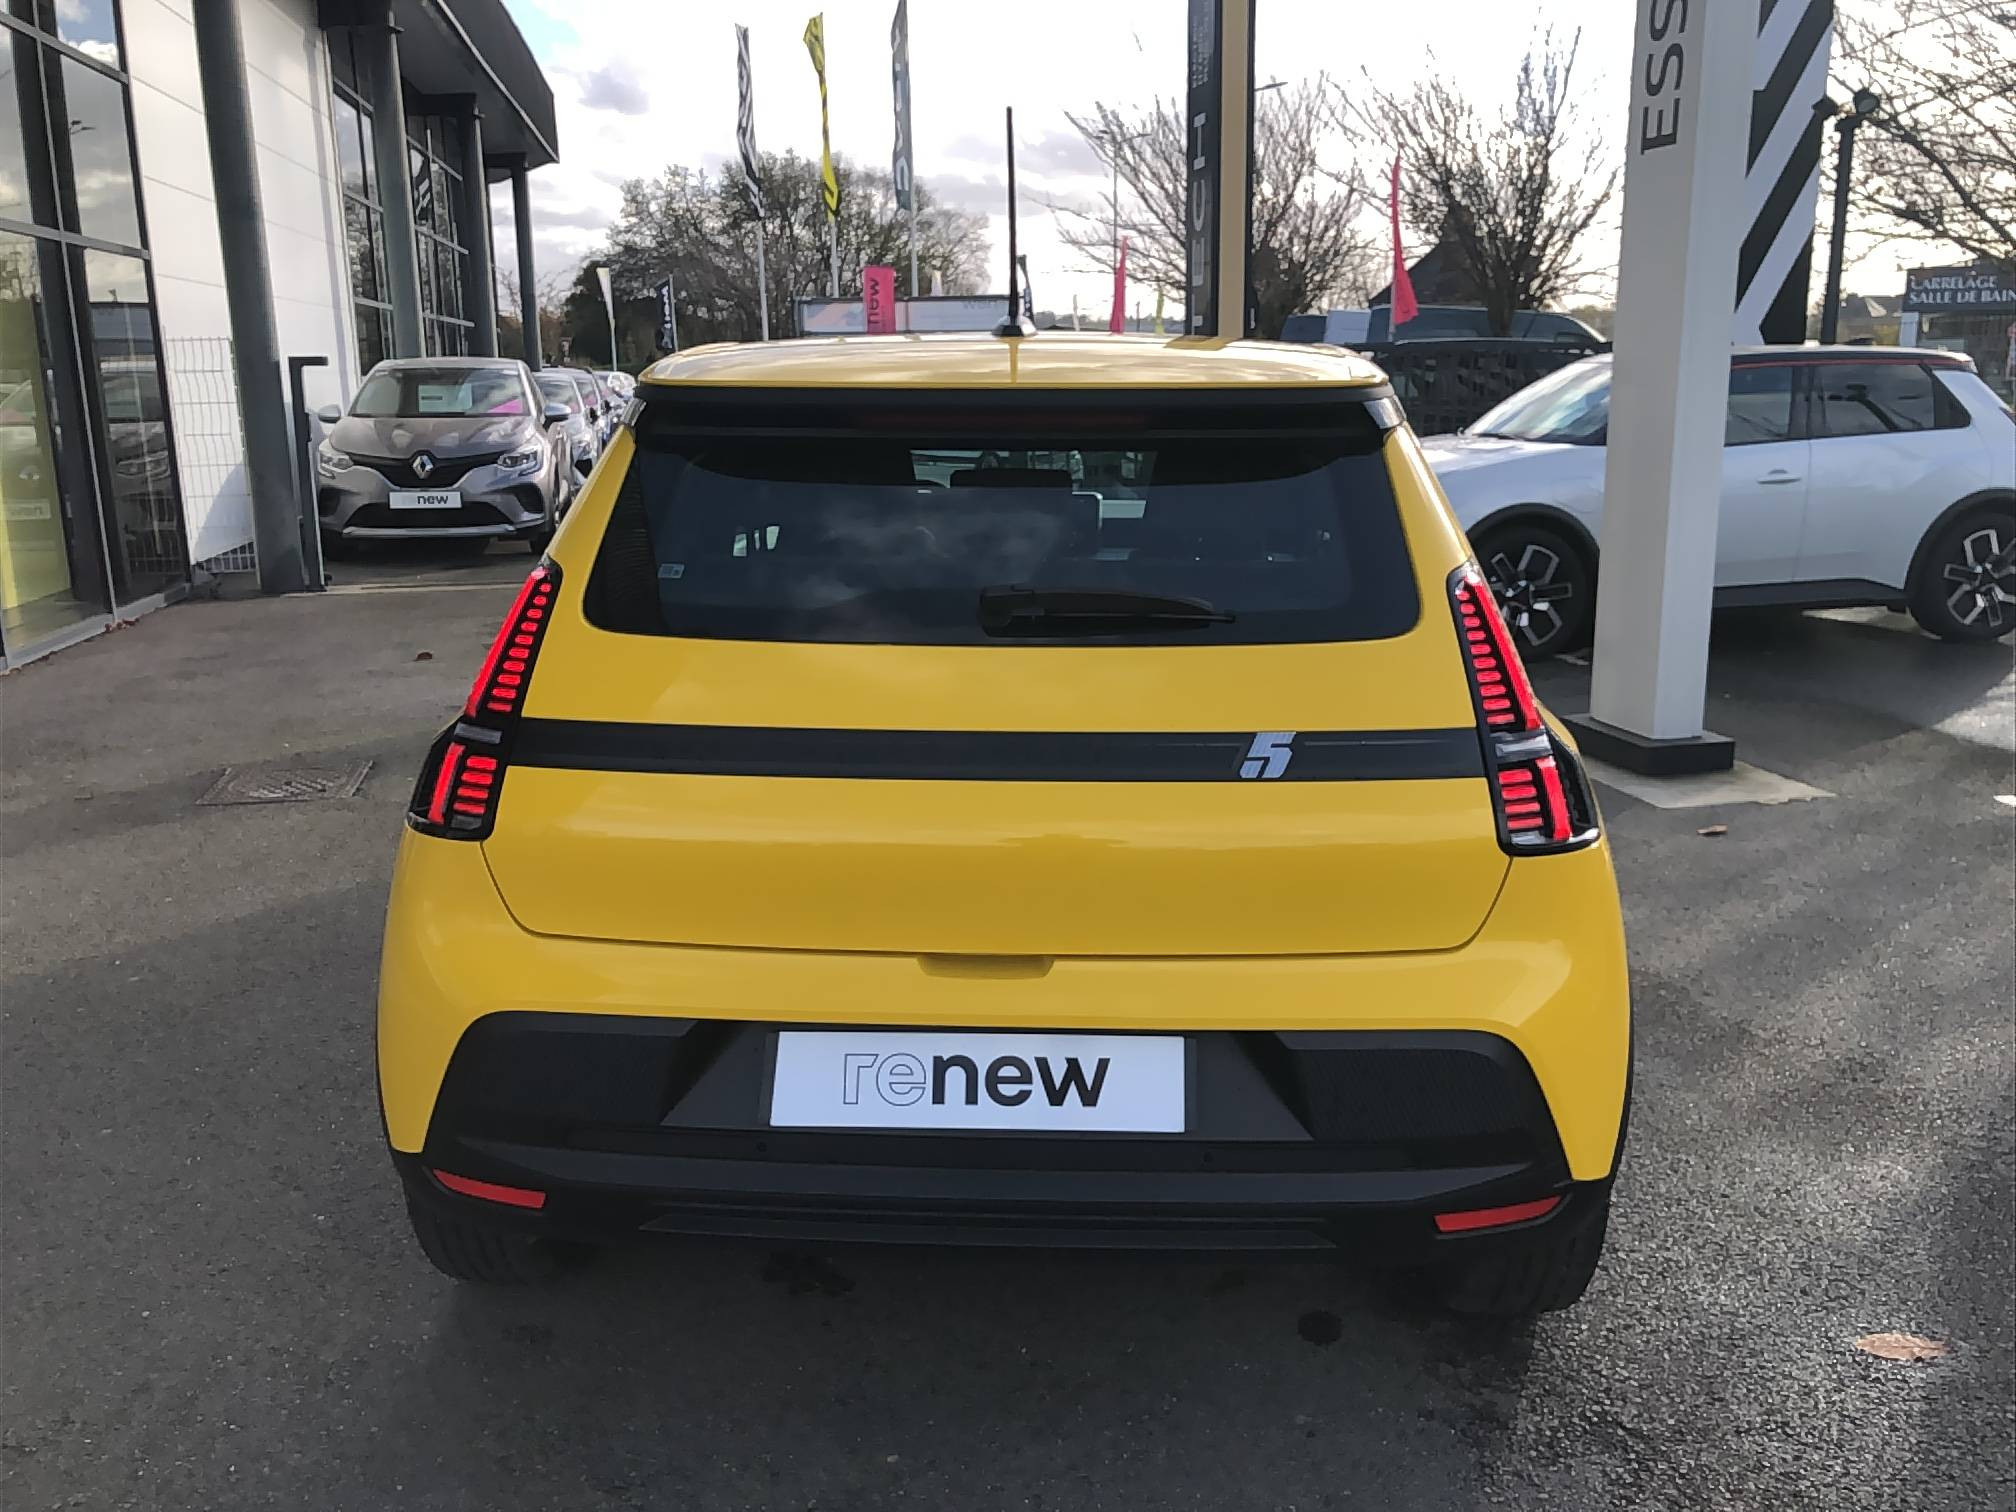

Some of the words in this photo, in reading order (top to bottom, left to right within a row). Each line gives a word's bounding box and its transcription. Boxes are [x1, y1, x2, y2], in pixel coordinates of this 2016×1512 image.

[1191, 112, 1206, 335] TECH
[1909, 291, 1952, 304] SALLE
[1957, 290, 1977, 303] DE
[1240, 731, 1297, 778] 5
[843, 1053, 1111, 1107] renew
